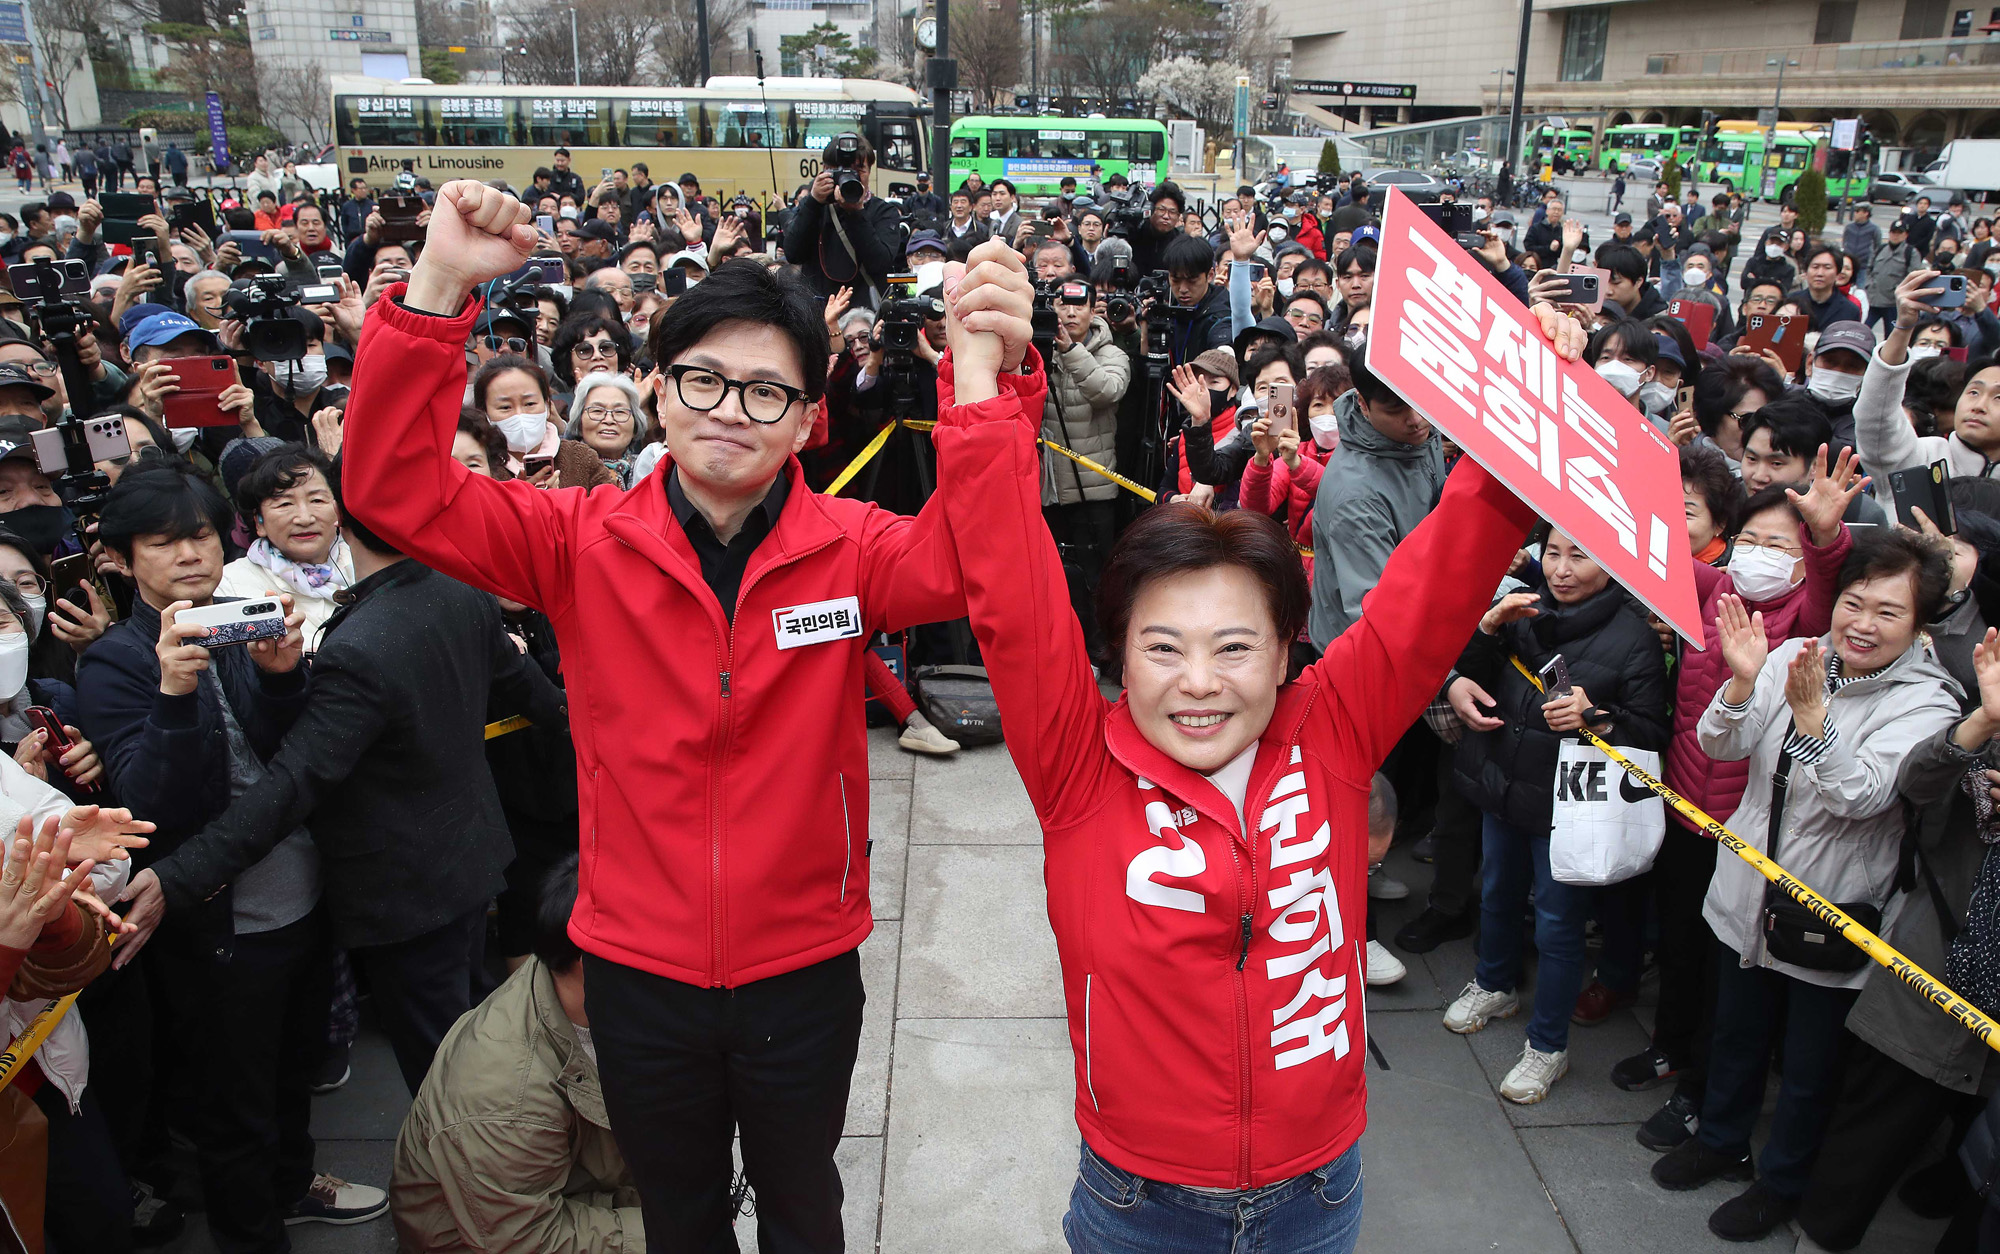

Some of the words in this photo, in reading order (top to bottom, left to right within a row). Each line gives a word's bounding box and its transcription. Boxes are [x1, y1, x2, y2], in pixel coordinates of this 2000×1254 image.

[358, 97, 412, 112] 왕십리역
[532, 99, 597, 113] 옥수동·한남역
[630, 100, 684, 112] 동부이촌동
[794, 102, 827, 114] 인천공항
[429, 156, 504, 169] Limousine
[800, 158, 823, 178] 60
[1405, 225, 1619, 469] 경제는
[1398, 299, 1670, 583] 윤희숙!
[785, 609, 851, 635] 국민의힘
